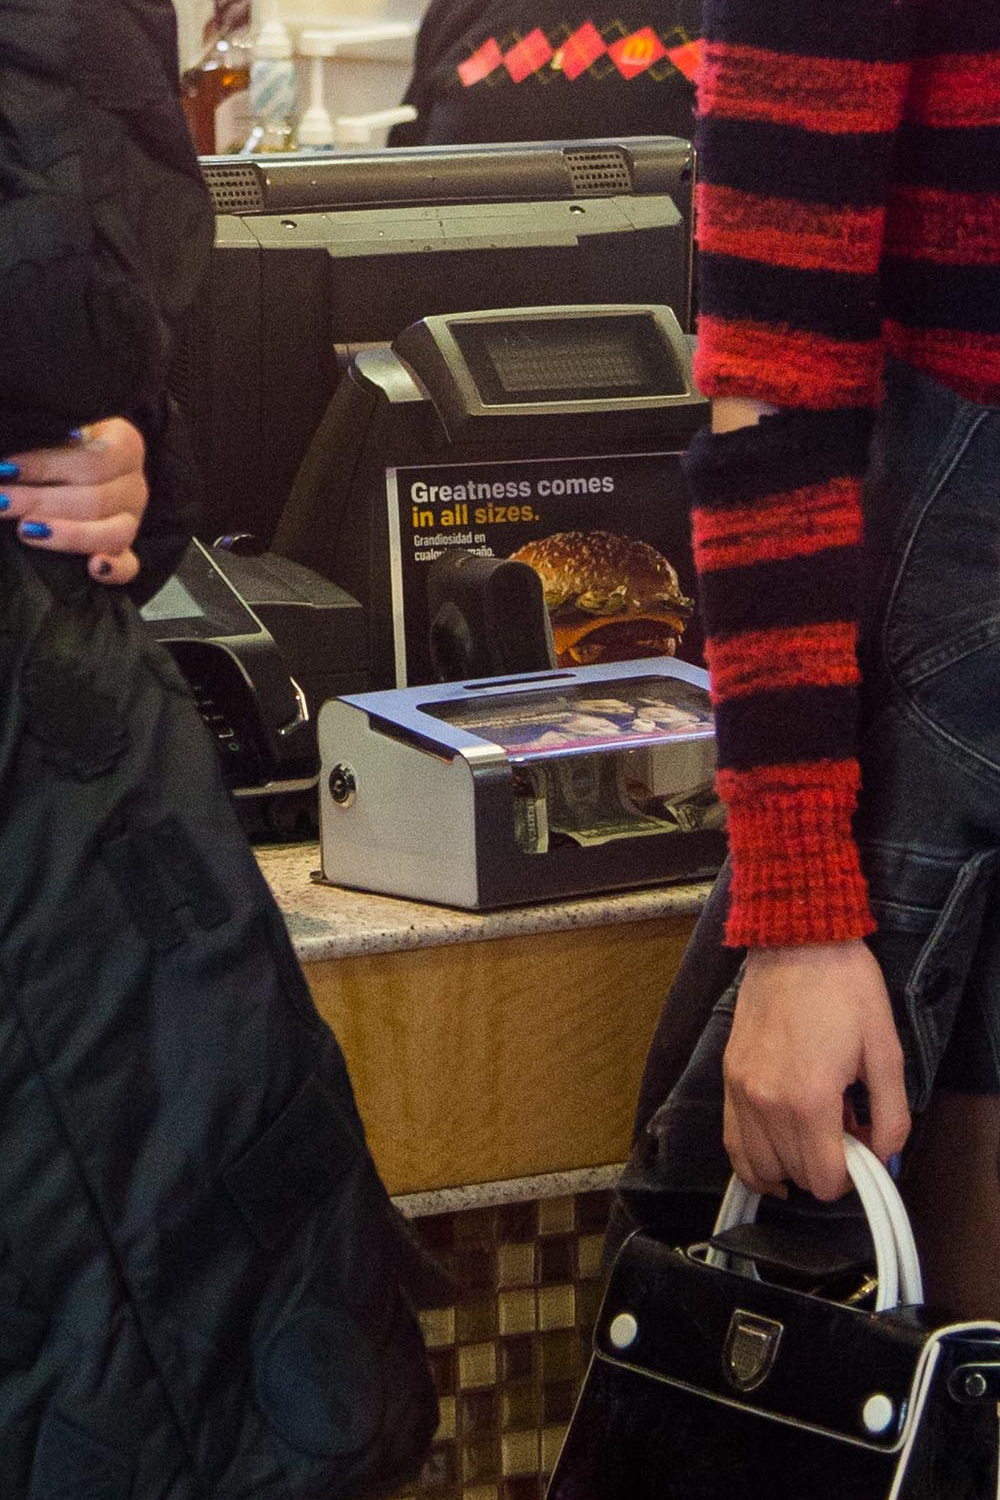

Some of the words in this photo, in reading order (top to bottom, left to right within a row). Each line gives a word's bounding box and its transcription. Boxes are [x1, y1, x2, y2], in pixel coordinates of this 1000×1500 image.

[411, 480, 531, 503] Greatness
[537, 475, 614, 497] comes
[412, 506, 434, 528] in
[440, 504, 468, 526] all
[474, 502, 540, 524] sizes.
[413, 532, 473, 547] Grandiosidad
[474, 533, 487, 543] en
